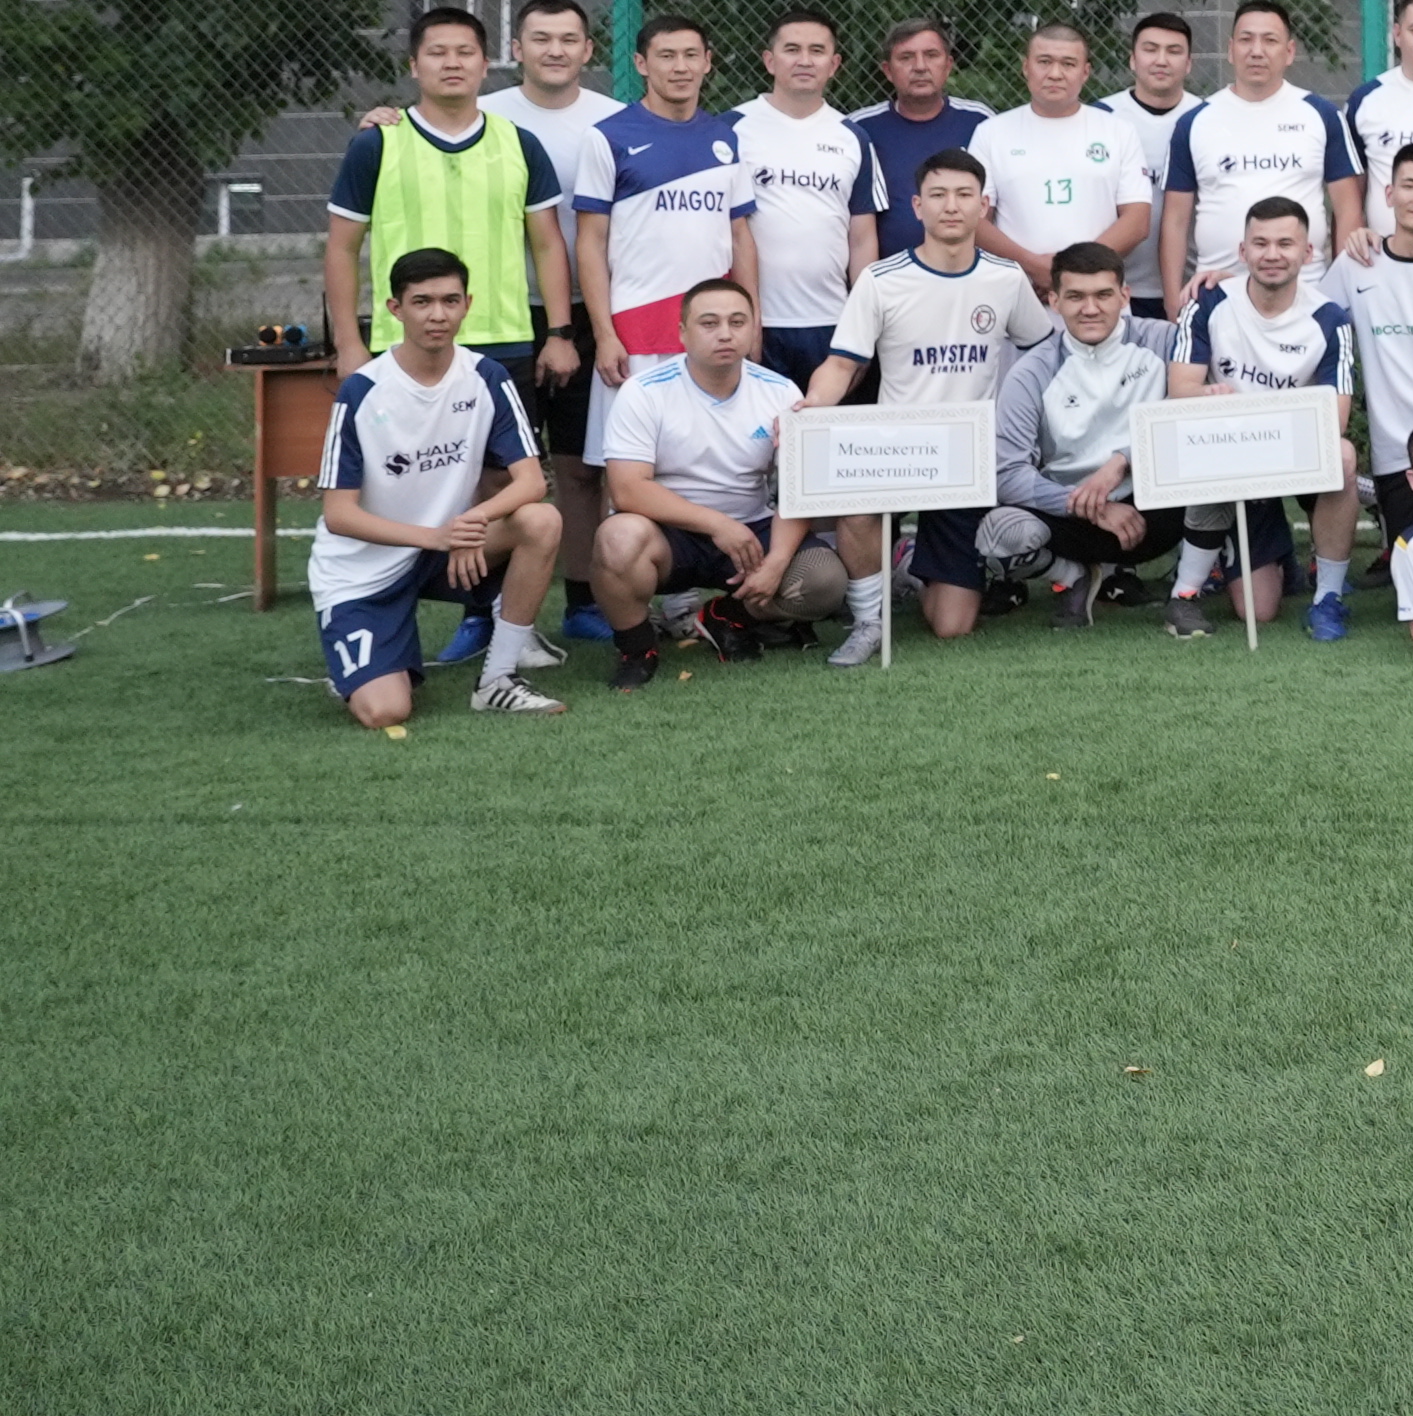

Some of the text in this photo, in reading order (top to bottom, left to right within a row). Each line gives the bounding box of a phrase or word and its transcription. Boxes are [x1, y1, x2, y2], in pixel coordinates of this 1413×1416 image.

[1243, 153, 1303, 172] Halyk
[780, 168, 841, 192] Halyk
[1044, 178, 1073, 205] 13
[655, 189, 725, 212] AYAGOZ
[912, 344, 989, 367] ARYSTAN
[1240, 362, 1299, 389] Halyk
[837, 441, 940, 457] Мемлекеттік
[1186, 430, 1282, 446] ХАЛЫҚ БАНКІ
[836, 463, 940, 481] қызметшілер
[333, 628, 374, 679] 17
